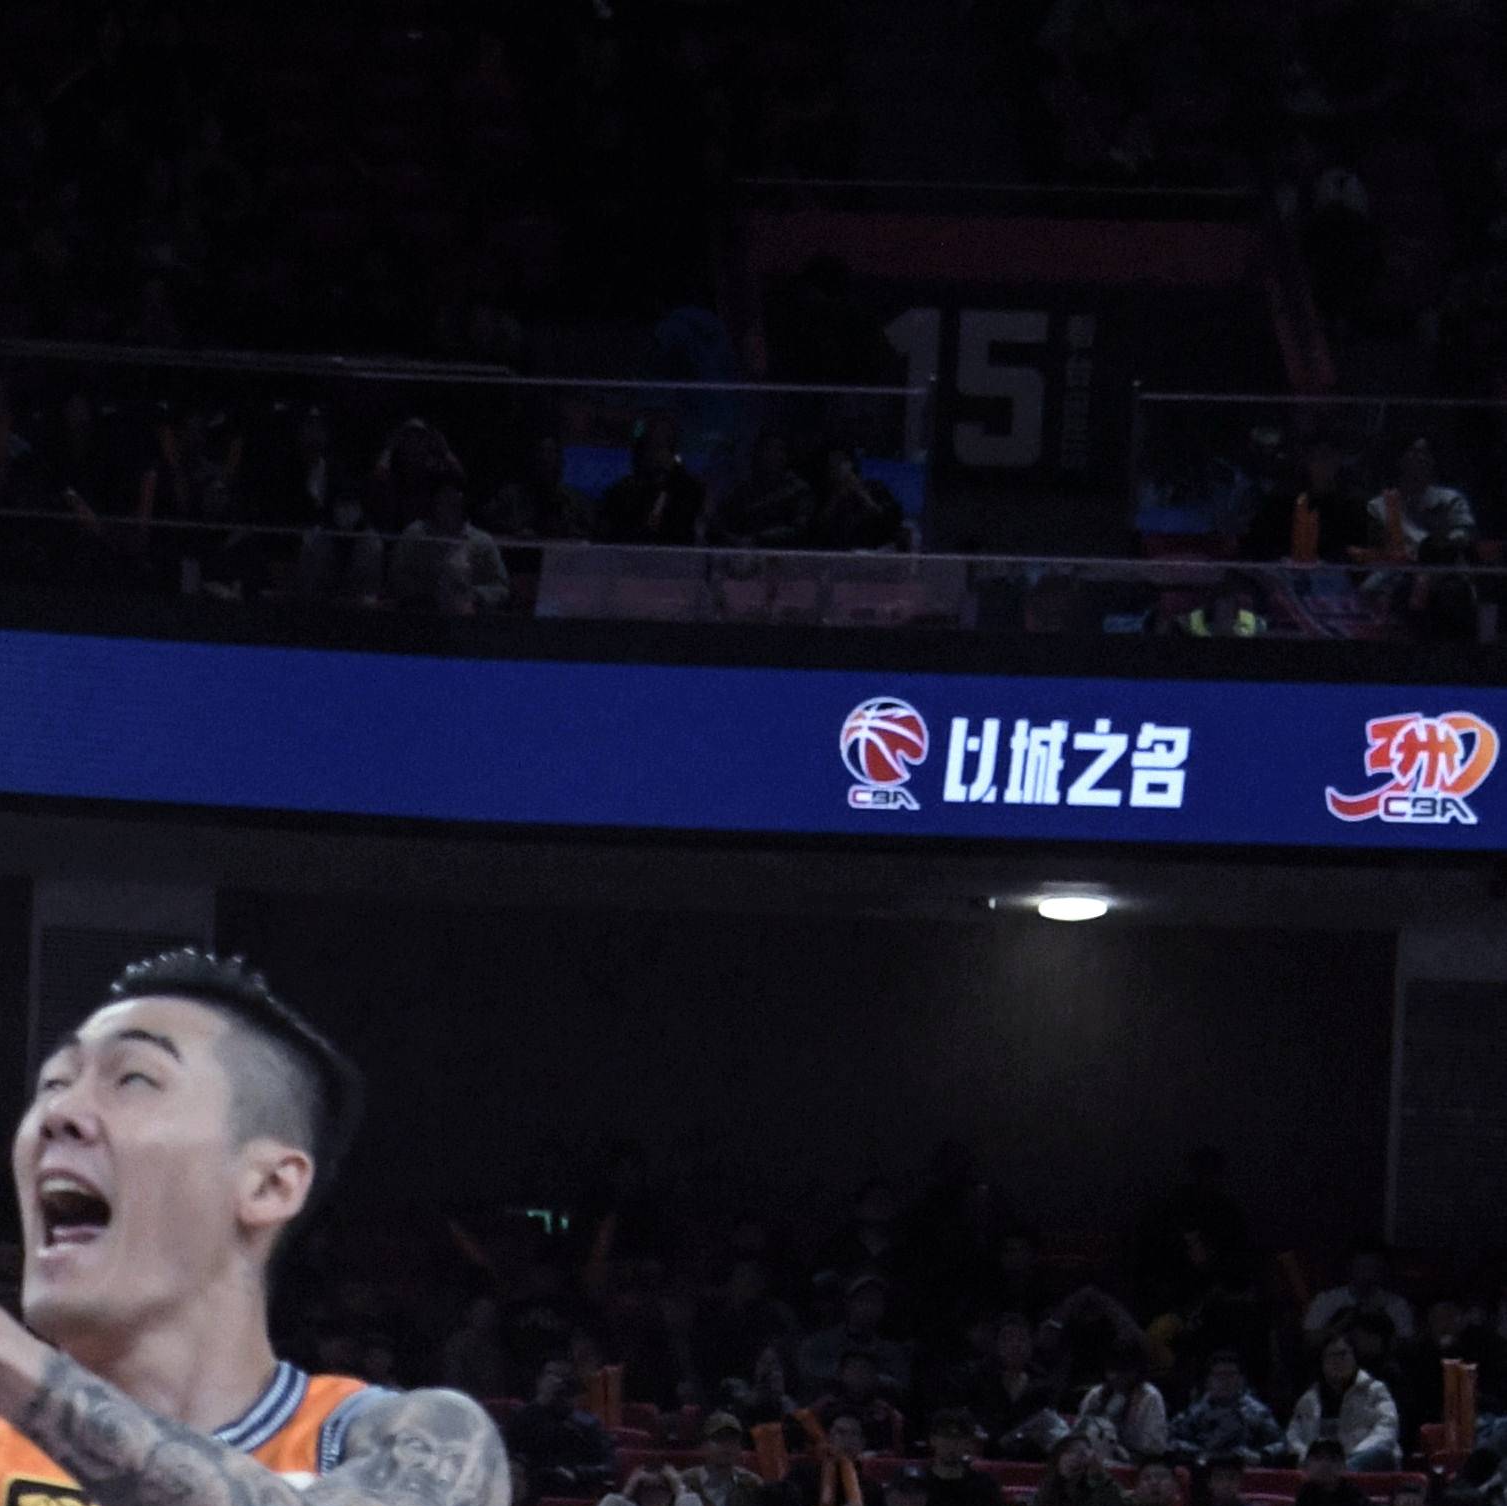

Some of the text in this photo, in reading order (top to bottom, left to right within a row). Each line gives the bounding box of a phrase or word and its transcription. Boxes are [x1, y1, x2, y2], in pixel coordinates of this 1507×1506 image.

[943, 716, 1192, 809] 以城之名
[1379, 793, 1479, 825] CBA
